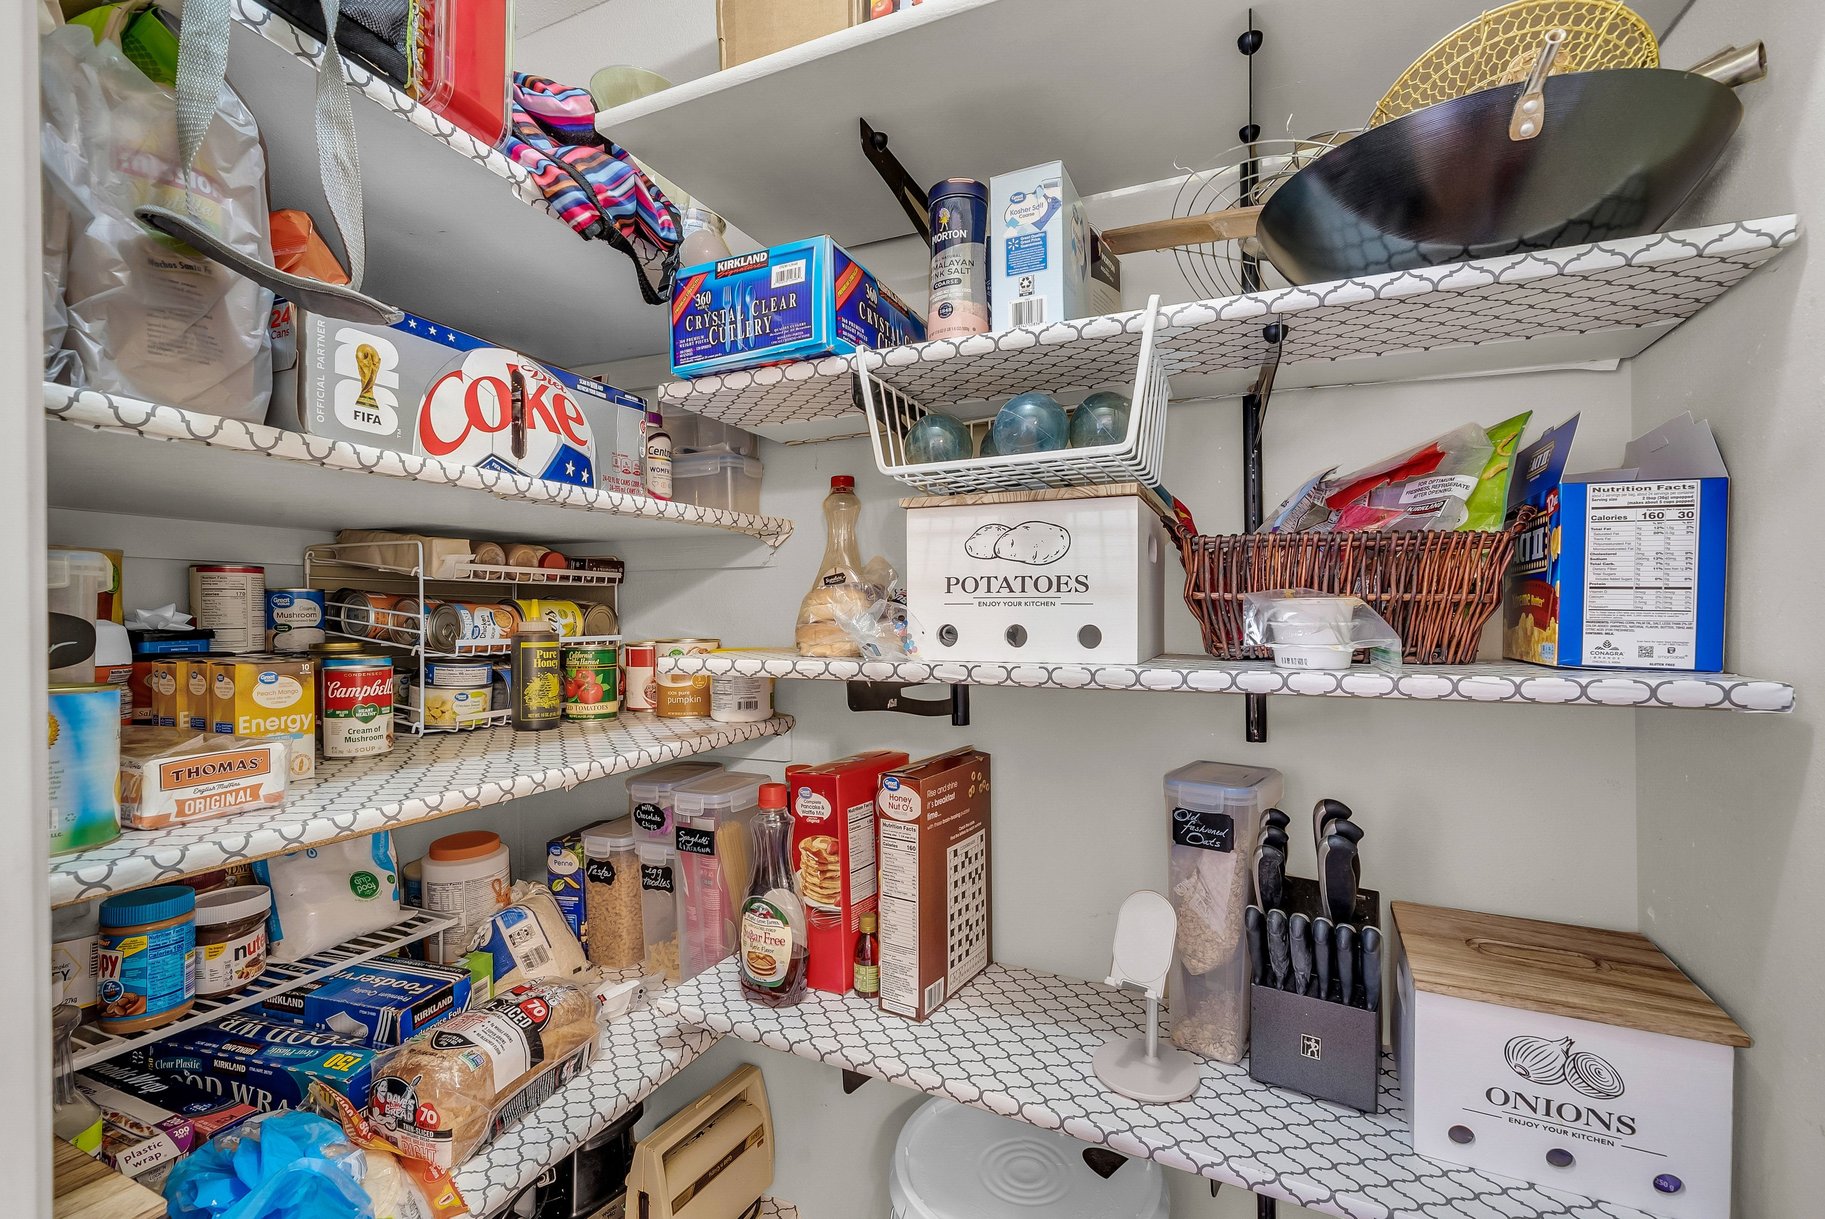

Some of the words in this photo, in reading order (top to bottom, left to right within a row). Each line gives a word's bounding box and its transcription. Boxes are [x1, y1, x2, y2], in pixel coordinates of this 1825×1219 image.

[1009, 206, 1031, 216] Kosher
[1032, 202, 1044, 212] Salt
[717, 252, 768, 272] KIRKLAND
[933, 259, 975, 271] MALAYAN
[717, 263, 768, 278] Signature
[947, 267, 971, 276] SALT
[934, 278, 959, 289] COARSE
[695, 291, 711, 307] 360
[270, 306, 291, 329] 24
[686, 307, 744, 332] CRYSTAL
[752, 293, 797, 317] CLEAR
[271, 328, 290, 340] Cans
[709, 316, 773, 346] CUTLERY
[317, 319, 326, 370] PARTNER
[521, 363, 567, 394] Diet
[316, 376, 325, 423] OFFICIAL
[419, 363, 588, 456] Coke
[353, 410, 382, 426] FIFA
[1592, 485, 1652, 493] Nutrition
[1407, 501, 1444, 512] KIRKLAND
[1641, 512, 1665, 520] 160
[1678, 511, 1695, 519] 30
[944, 574, 1090, 594] POTATOES
[276, 611, 317, 619] Mushroom
[479, 614, 487, 639] Chicken
[536, 649, 557, 659] Pure
[568, 651, 595, 660] California
[533, 658, 558, 669] Honey
[580, 658, 600, 666] Harvest
[278, 688, 299, 696] Mango
[667, 694, 702, 705] pumpkin
[574, 704, 609, 712] TOMATOES
[239, 712, 313, 735] Energy
[347, 727, 373, 735] Cream
[373, 725, 381, 733] of
[344, 734, 384, 744] Mushroom
[193, 785, 216, 795] English
[216, 782, 241, 791] Muffins
[926, 789, 937, 799] Rise
[937, 785, 947, 795] and
[946, 781, 959, 791] shine
[185, 788, 253, 815] ORIGINAL
[889, 793, 913, 805] Honey
[934, 792, 956, 807] breakfast
[848, 805, 863, 813] Nutrition
[888, 802, 901, 811] Nut
[901, 803, 914, 813] O's
[636, 809, 662, 822] Chocolate
[1174, 809, 1200, 822] Old
[882, 822, 902, 830] Nutrition
[903, 825, 917, 833] Facts
[678, 830, 711, 846] Spaghetti
[1186, 832, 1220, 848] Oats
[882, 841, 898, 849] Calories
[906, 844, 917, 852] 160
[553, 859, 574, 868] Penne
[587, 864, 612, 880] Pasta
[354, 874, 372, 886] club
[643, 876, 671, 889] noodles
[356, 882, 377, 894] food
[148, 930, 171, 940] Nutrition
[742, 924, 763, 943] Sugar
[763, 931, 786, 946] Free
[234, 931, 267, 962] nute
[148, 948, 173, 959] Calories
[328, 970, 434, 996] Foodservi
[352, 987, 378, 997] Quality
[378, 992, 412, 1003] Premium
[414, 995, 453, 1024] KIRKLAND
[448, 1007, 462, 1019] Foil
[527, 1000, 546, 1017] 70
[222, 1043, 258, 1056] KIRKLAND
[267, 1045, 297, 1057] Plastic
[298, 1047, 319, 1058] Clear
[155, 1058, 174, 1070] Clear
[175, 1057, 200, 1070] Plastic
[213, 1058, 247, 1073] KIRKLAND
[322, 1053, 362, 1072] 150
[128, 1073, 169, 1095] Wrap
[386, 1091, 416, 1111] DAVE'S
[385, 1104, 414, 1123] BREAD
[420, 1106, 438, 1125] 70
[1485, 1086, 1637, 1136] ONIONS
[173, 1126, 190, 1138] 200
[403, 1123, 434, 1138] THIN-SLICED
[1508, 1117, 1540, 1130] ENJOY
[1543, 1125, 1569, 1137] YOUR
[1571, 1132, 1615, 1148] KITCHEN
[123, 1140, 164, 1164] plastic
[401, 1140, 436, 1163] RIGHT
[132, 1152, 162, 1169] wrap
